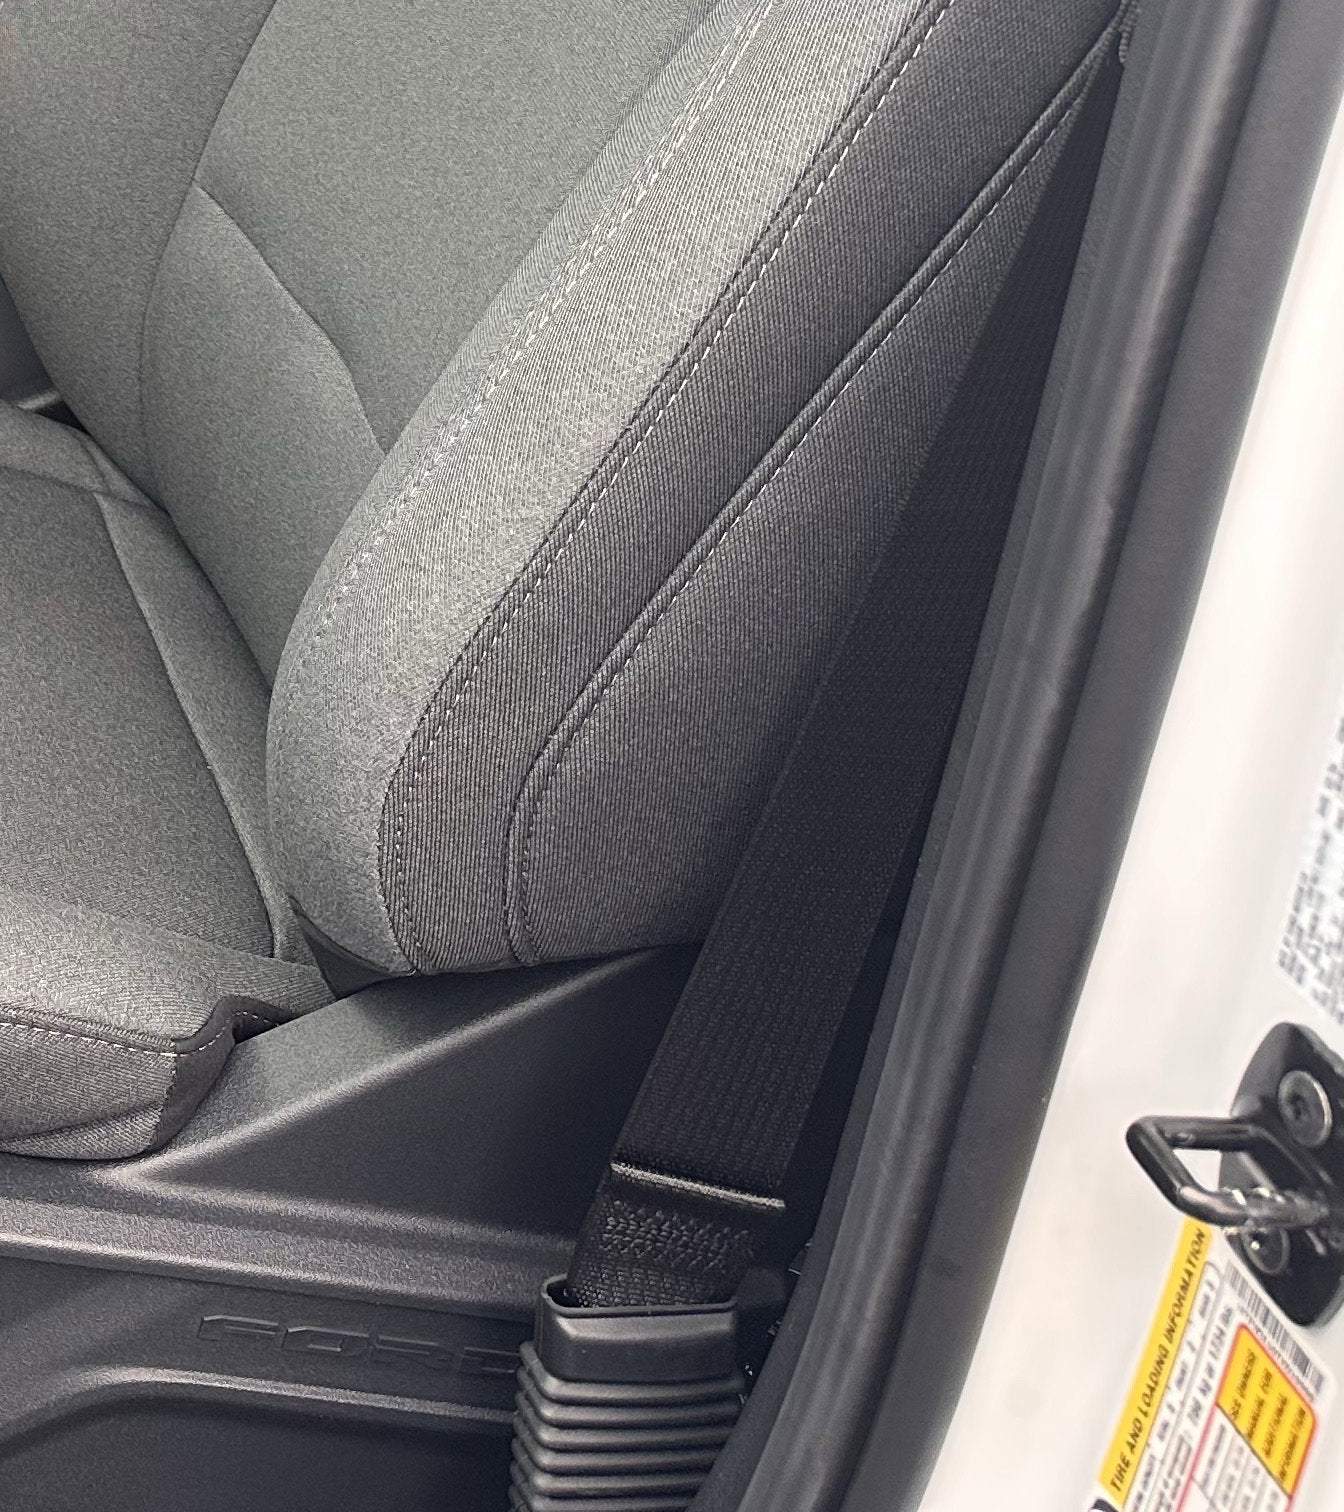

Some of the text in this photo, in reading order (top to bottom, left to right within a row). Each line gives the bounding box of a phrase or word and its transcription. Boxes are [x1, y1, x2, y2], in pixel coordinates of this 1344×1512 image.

[1111, 1455, 1130, 1493] TIRE
[1125, 1414, 1144, 1455] AND
[1138, 1342, 1169, 1418] LOADING
[1162, 1227, 1207, 1345] INFORMATION
